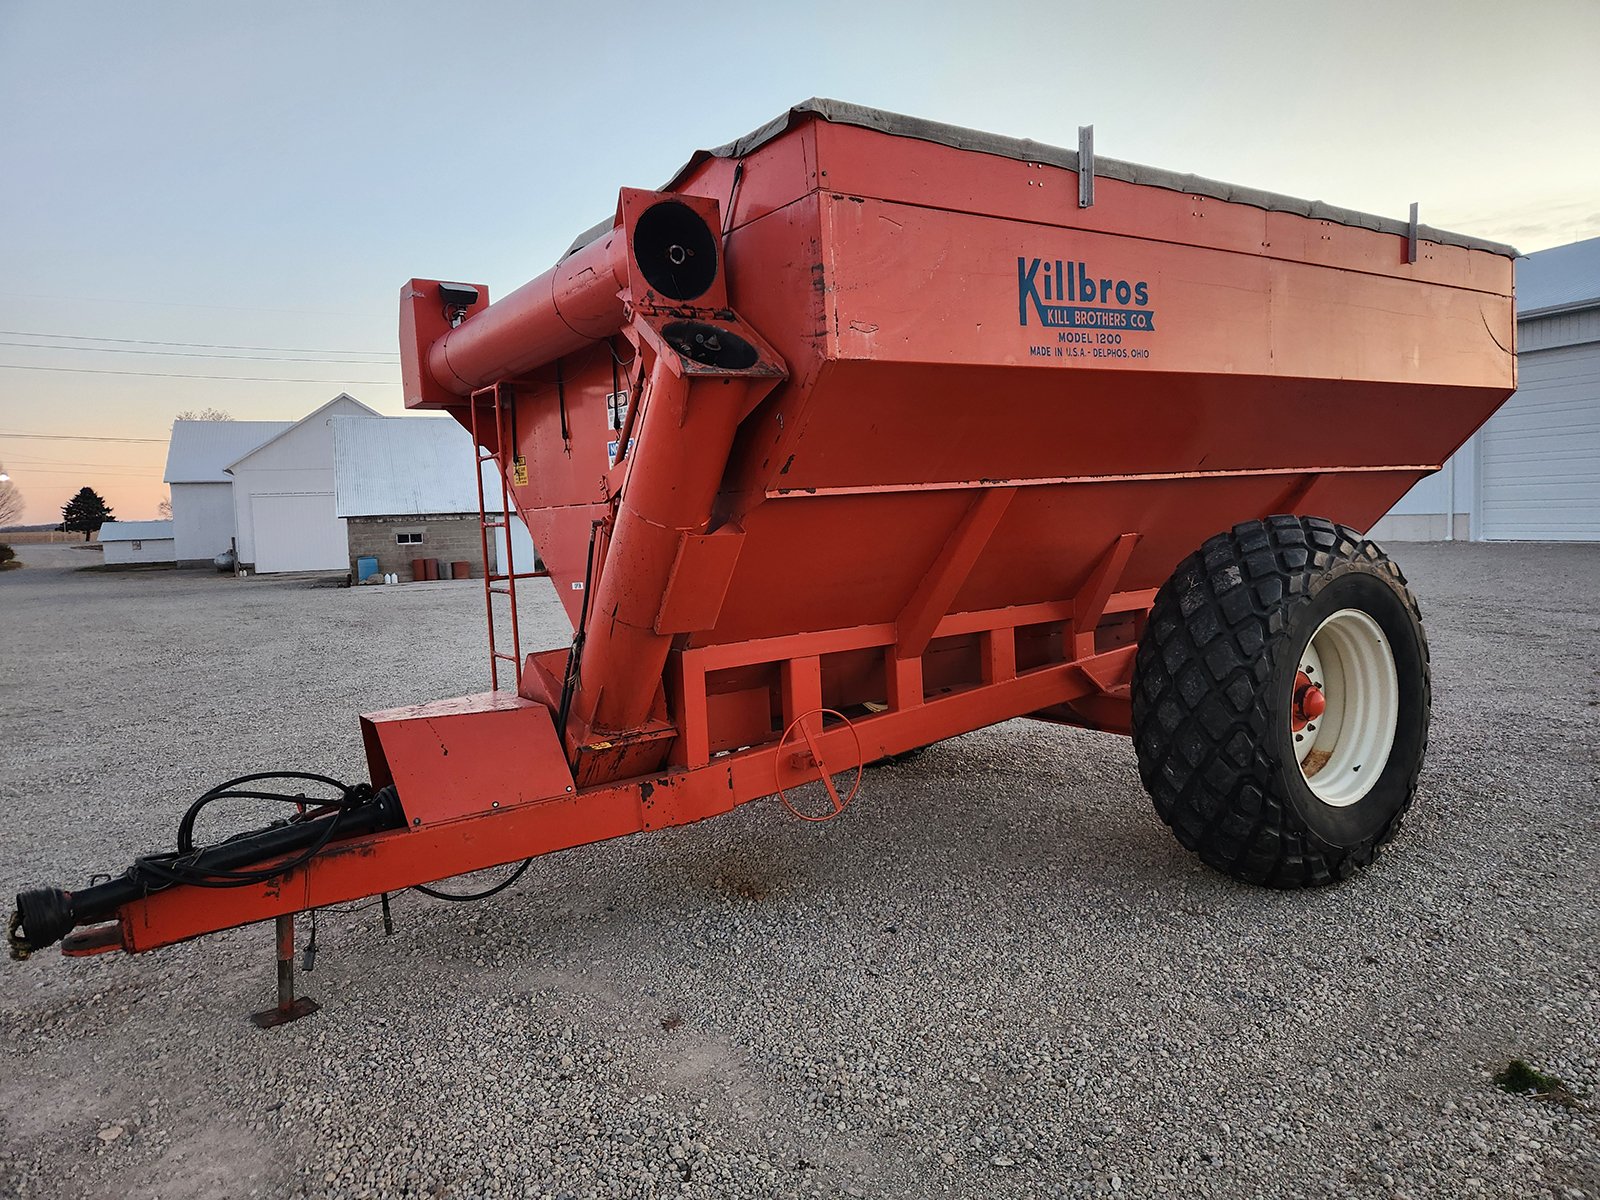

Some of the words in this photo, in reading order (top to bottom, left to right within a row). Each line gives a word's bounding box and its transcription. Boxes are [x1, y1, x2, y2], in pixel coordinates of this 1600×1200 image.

[1017, 256, 1149, 326] Killbros
[1047, 308, 1070, 325] KILL
[1074, 310, 1126, 327] BROTHERS
[1130, 313, 1148, 328] CO.
[1058, 332, 1093, 344] MODEL
[1095, 333, 1122, 345] 1200
[1030, 346, 1051, 357] MADE
[1054, 347, 1063, 357] IN
[1131, 349, 1150, 359] OHIO
